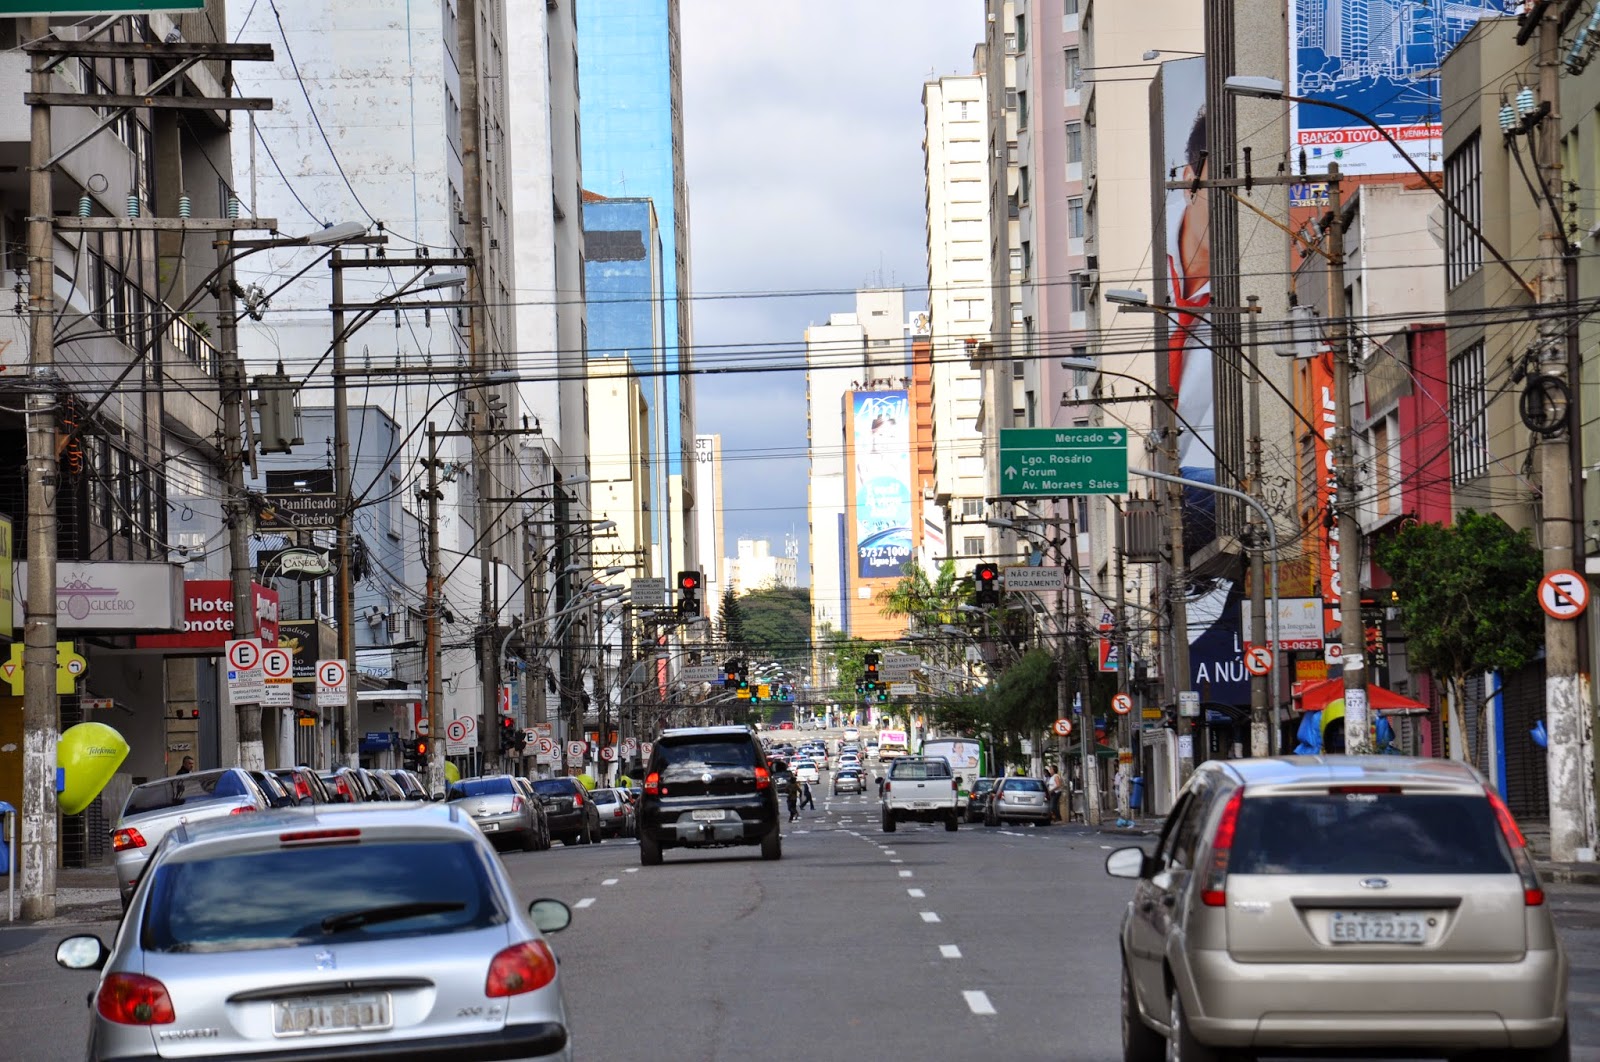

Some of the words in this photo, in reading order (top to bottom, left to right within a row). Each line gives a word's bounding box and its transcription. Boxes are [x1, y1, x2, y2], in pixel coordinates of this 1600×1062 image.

[1301, 131, 1343, 144] BANCO
[1403, 129, 1429, 138] VENHA
[857, 396, 908, 420] Amil
[1055, 433, 1104, 443] Mercado
[1021, 455, 1046, 466] Lgo.
[1021, 468, 1057, 477] Forum
[1021, 480, 1038, 490] Av.
[1041, 480, 1083, 489] Moraes
[1088, 479, 1120, 489] Sales
[860, 546, 909, 558] 3737-1000
[1011, 569, 1028, 577] NÃO
[1008, 579, 1061, 587] CRUZAMENTO
[1554, 581, 1573, 607] E
[90, 597, 135, 611] GLICÉRIO
[239, 647, 250, 664] E
[1255, 653, 1264, 668] E
[271, 656, 280, 670] E
[327, 668, 336, 681] E
[1196, 663, 1210, 684] A
[453, 726, 460, 737] E
[527, 732, 534, 742] E
[169, 742, 191, 752] 1422
[573, 745, 578, 753] E
